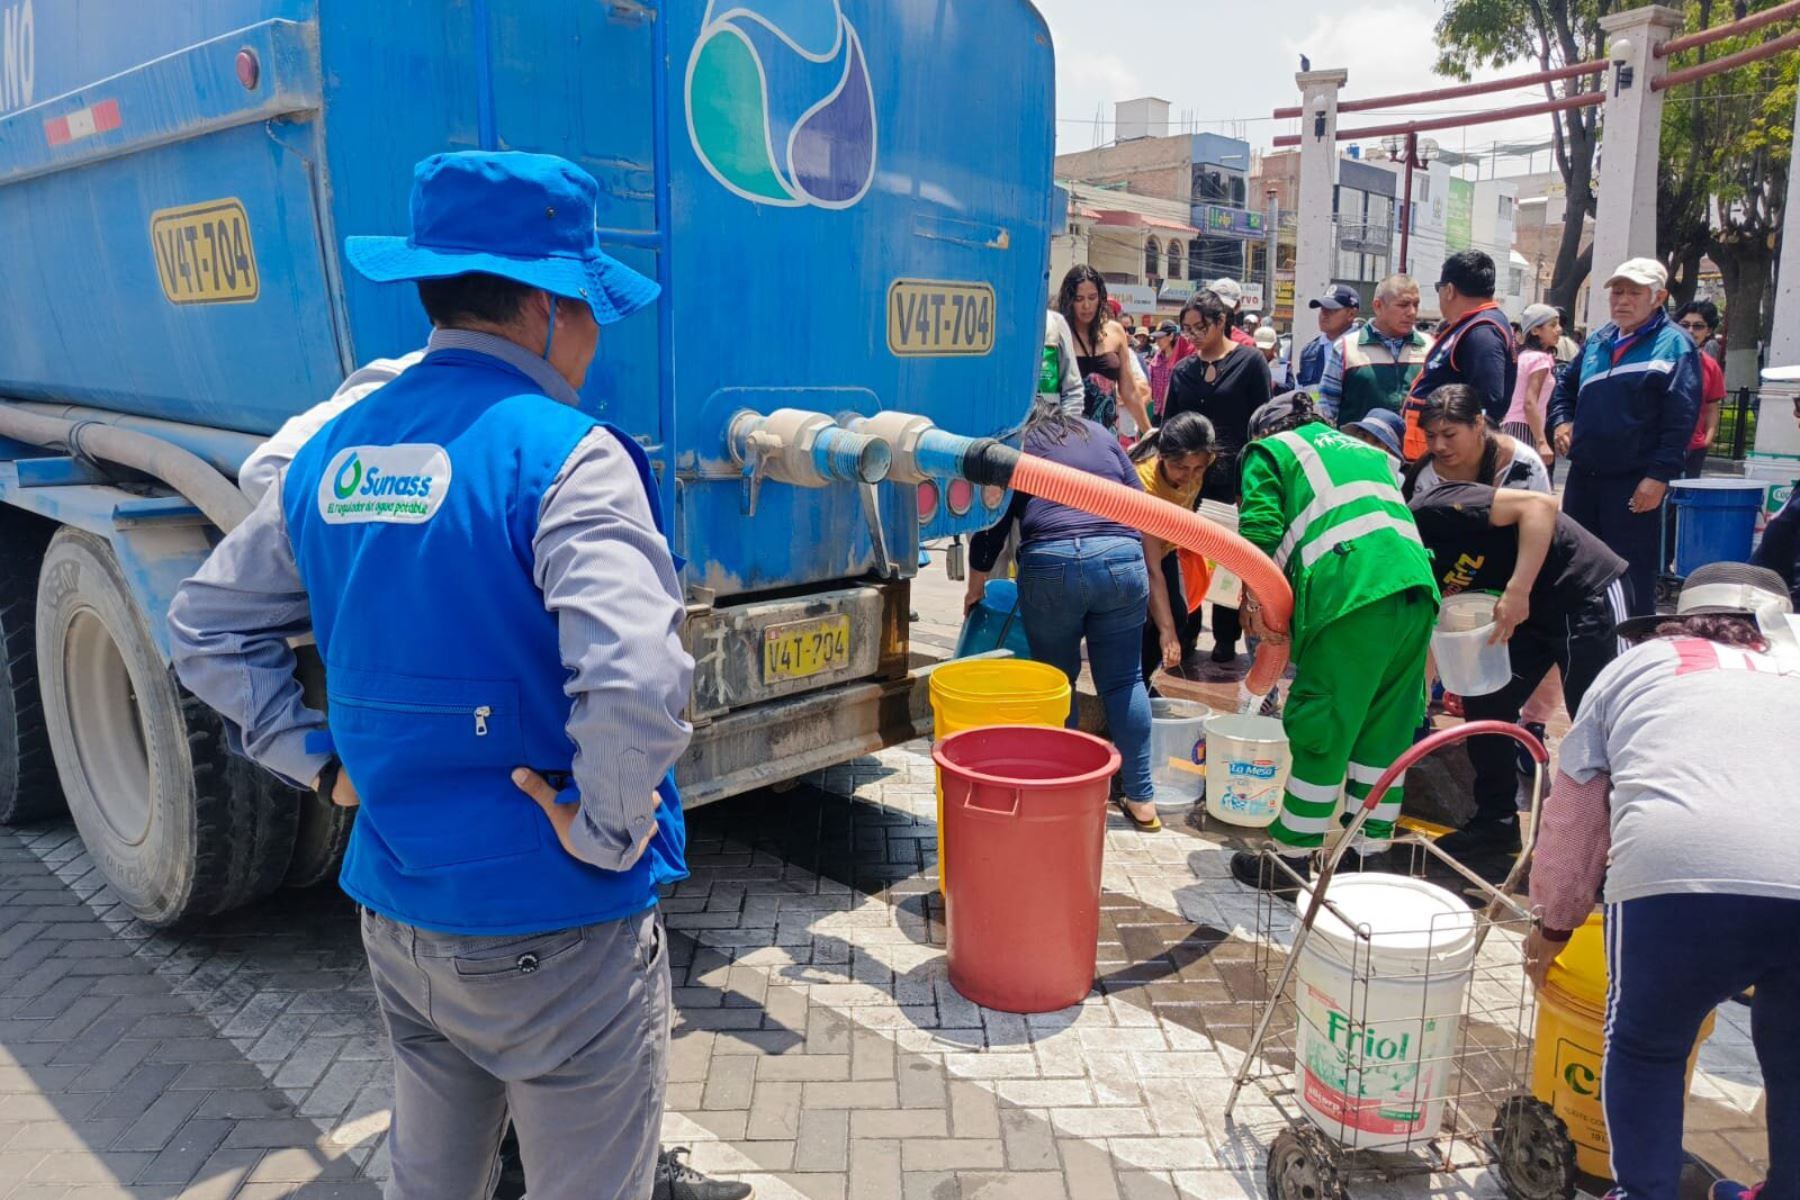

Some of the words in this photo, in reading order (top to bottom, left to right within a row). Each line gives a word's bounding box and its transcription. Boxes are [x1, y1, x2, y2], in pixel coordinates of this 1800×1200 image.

[0, 0, 35, 112] NO
[157, 217, 251, 294] V4T-704
[896, 292, 989, 345] V4T-704
[360, 466, 432, 497] Sunass
[769, 630, 845, 673] V4T-704
[1231, 763, 1244, 773] La
[1246, 765, 1273, 776] Mesa
[1326, 1009, 1410, 1062] Friol
